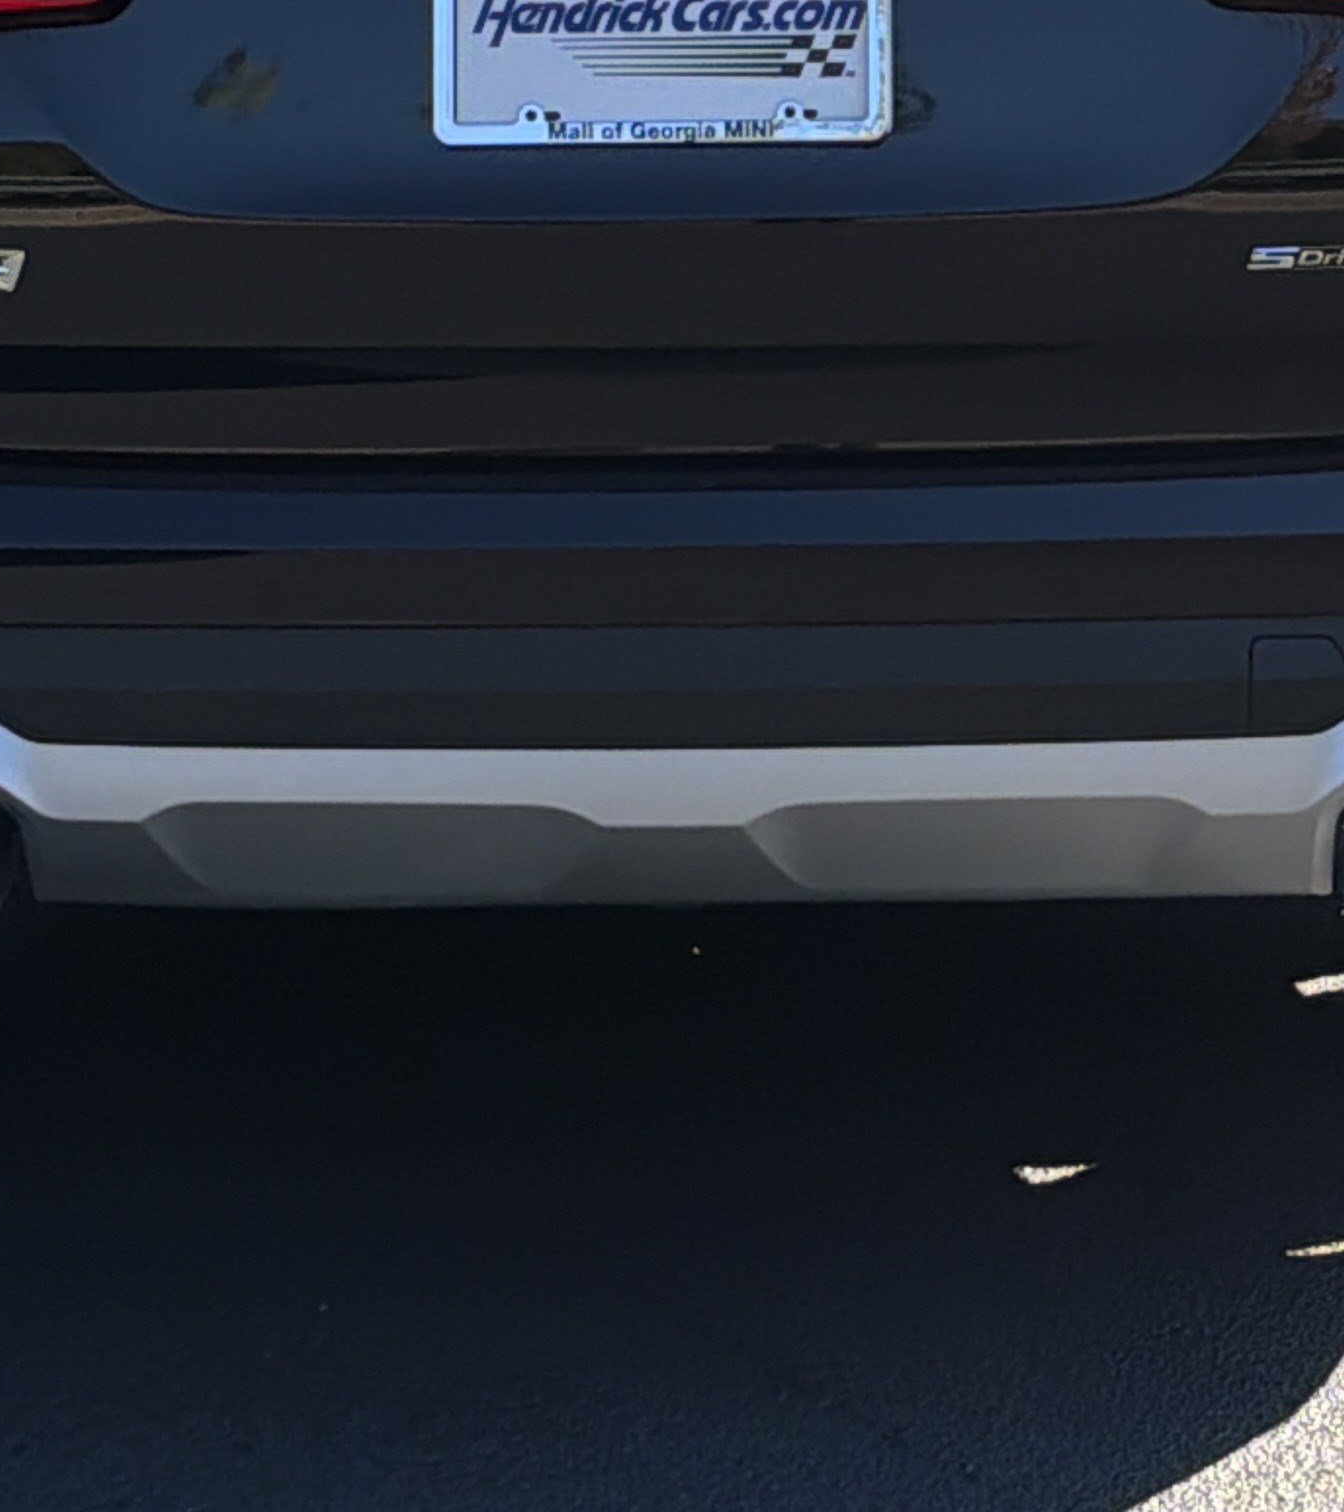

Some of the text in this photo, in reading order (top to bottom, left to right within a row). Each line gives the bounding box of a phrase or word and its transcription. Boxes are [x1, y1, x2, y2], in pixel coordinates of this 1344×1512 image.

[548, 121, 594, 139] Mall
[601, 121, 623, 139] of
[630, 121, 716, 143] Georgia
